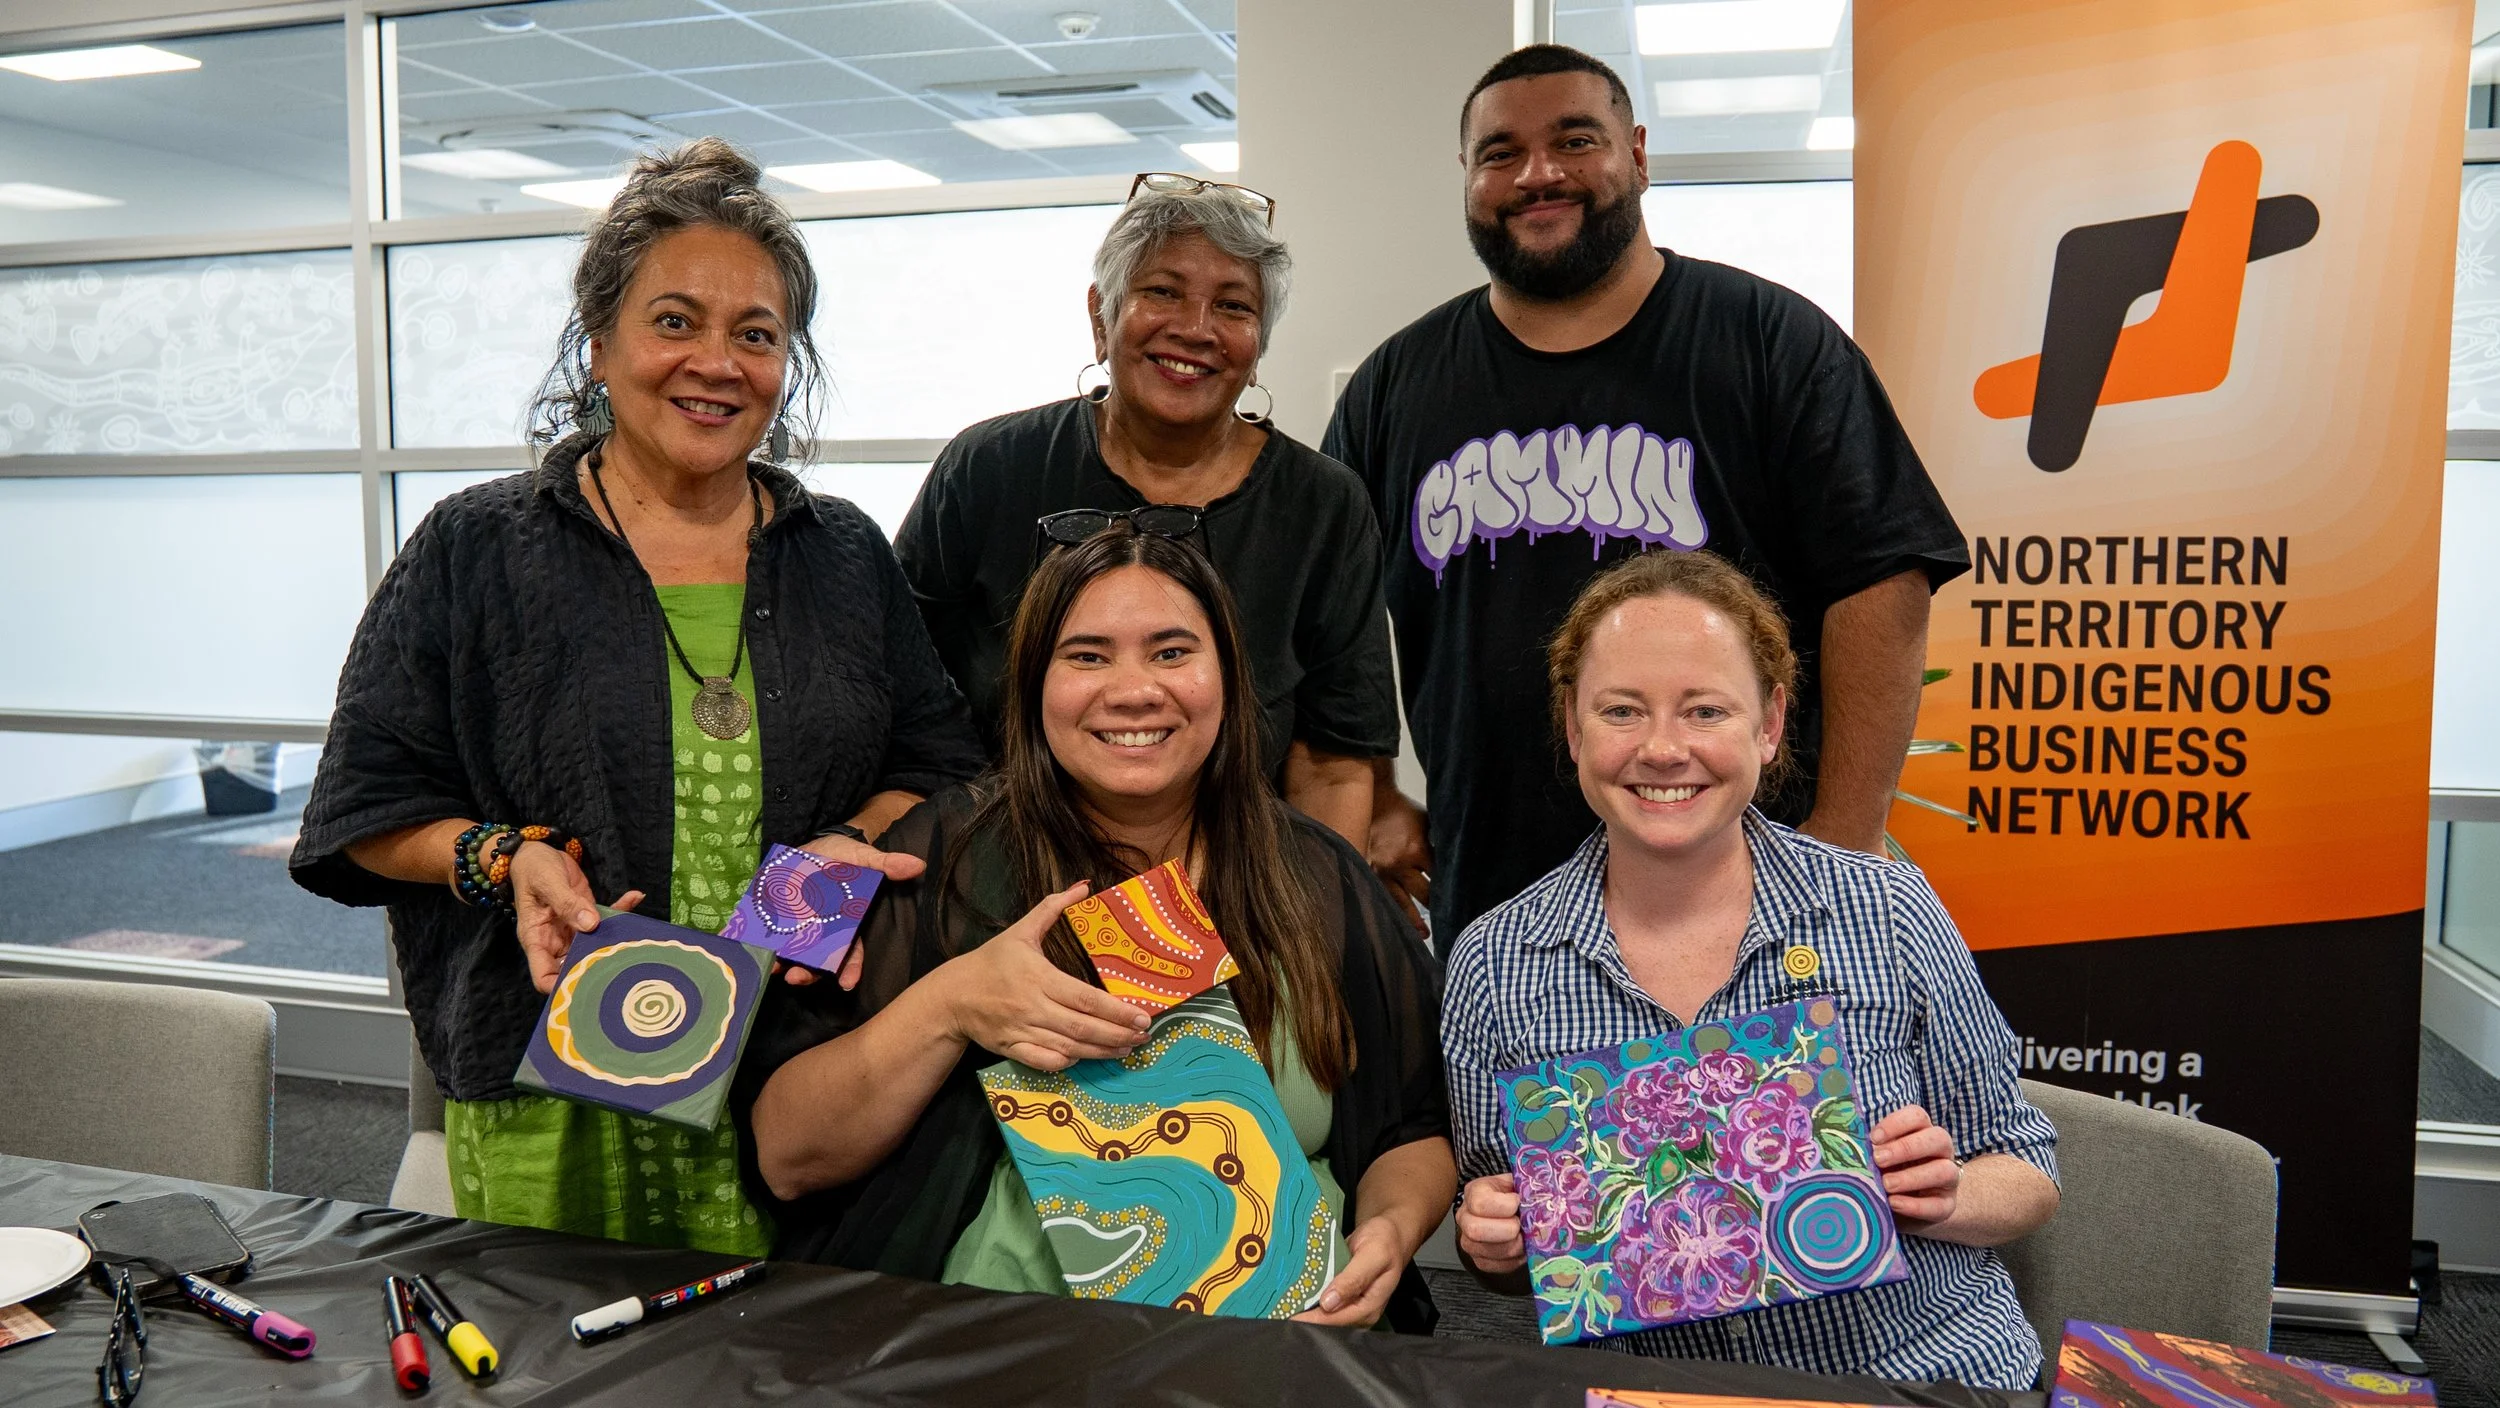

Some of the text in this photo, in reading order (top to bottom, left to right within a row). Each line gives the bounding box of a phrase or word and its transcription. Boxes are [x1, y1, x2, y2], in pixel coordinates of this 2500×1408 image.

[1412, 423, 1708, 572] GAMMIN
[1975, 535, 2289, 585] NORTHERN
[1971, 599, 2287, 650] TERRITORY
[1971, 662, 2332, 716] INDIGENOUS
[1969, 724, 2248, 777] BUSINESS
[1966, 786, 2251, 840] NETWORK
[2015, 1037, 2202, 1083] livering a
